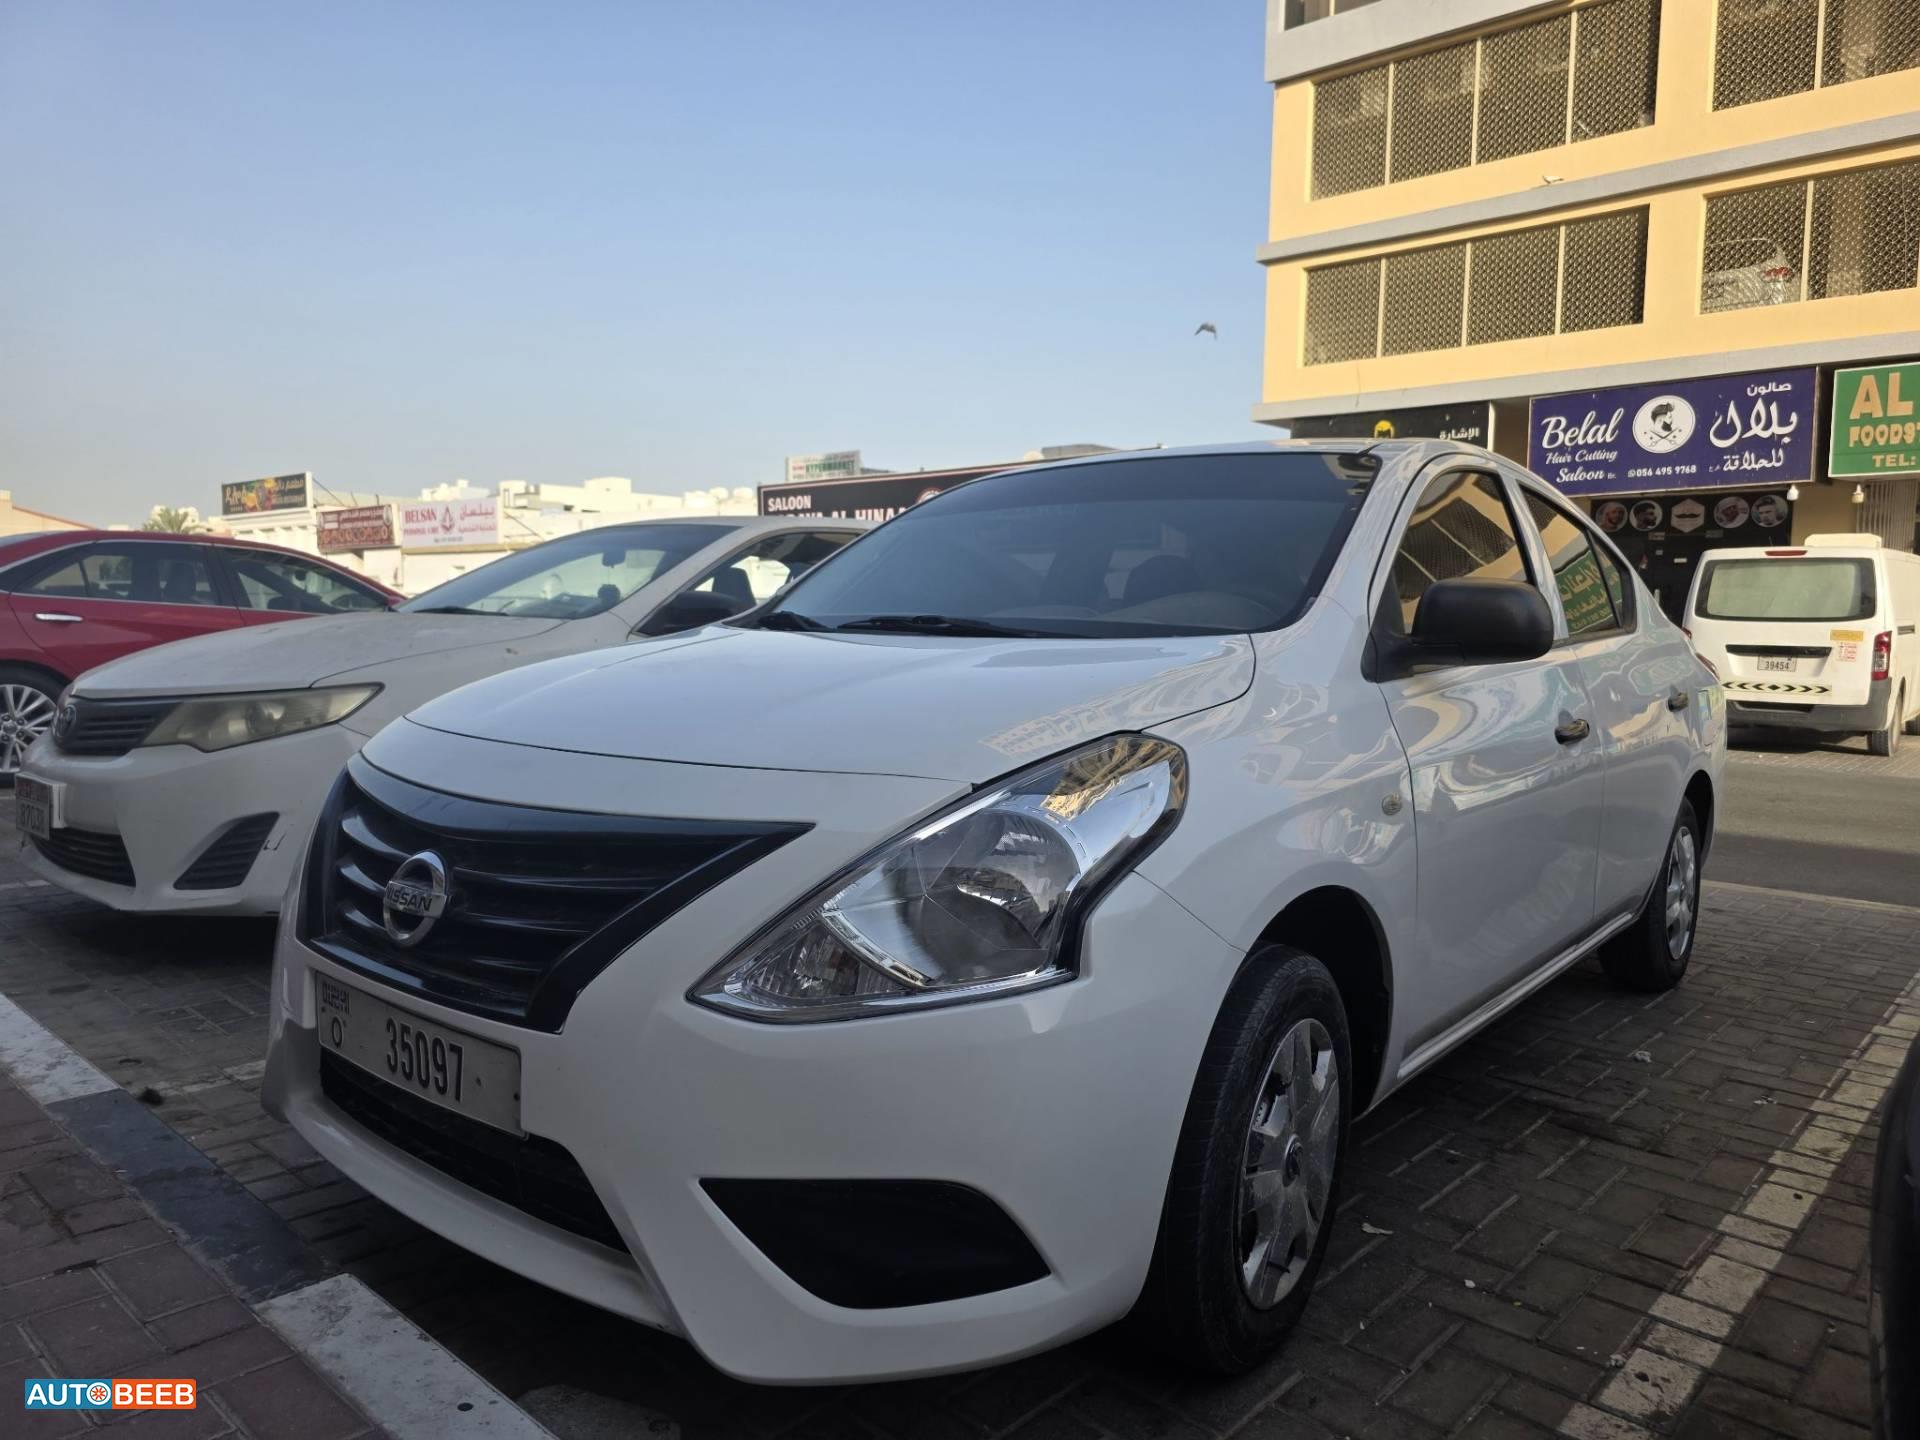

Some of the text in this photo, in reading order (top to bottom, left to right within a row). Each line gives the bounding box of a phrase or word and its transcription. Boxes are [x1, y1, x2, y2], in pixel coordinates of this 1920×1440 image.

[1746, 381, 1792, 397] صالون
[1849, 372, 1914, 420] AL
[1541, 407, 1625, 449] Belal
[1709, 398, 1798, 448] بلال
[1545, 448, 1619, 465] Hair Cutting
[1723, 448, 1784, 472] للحلاقة
[1872, 453, 1917, 467] TEL:
[1556, 466, 1604, 483] Saloon
[1636, 464, 1697, 477] 056 495 9768
[767, 494, 812, 512] SALOON
[386, 884, 434, 914] NISSAN
[386, 1015, 465, 1103] 35097
